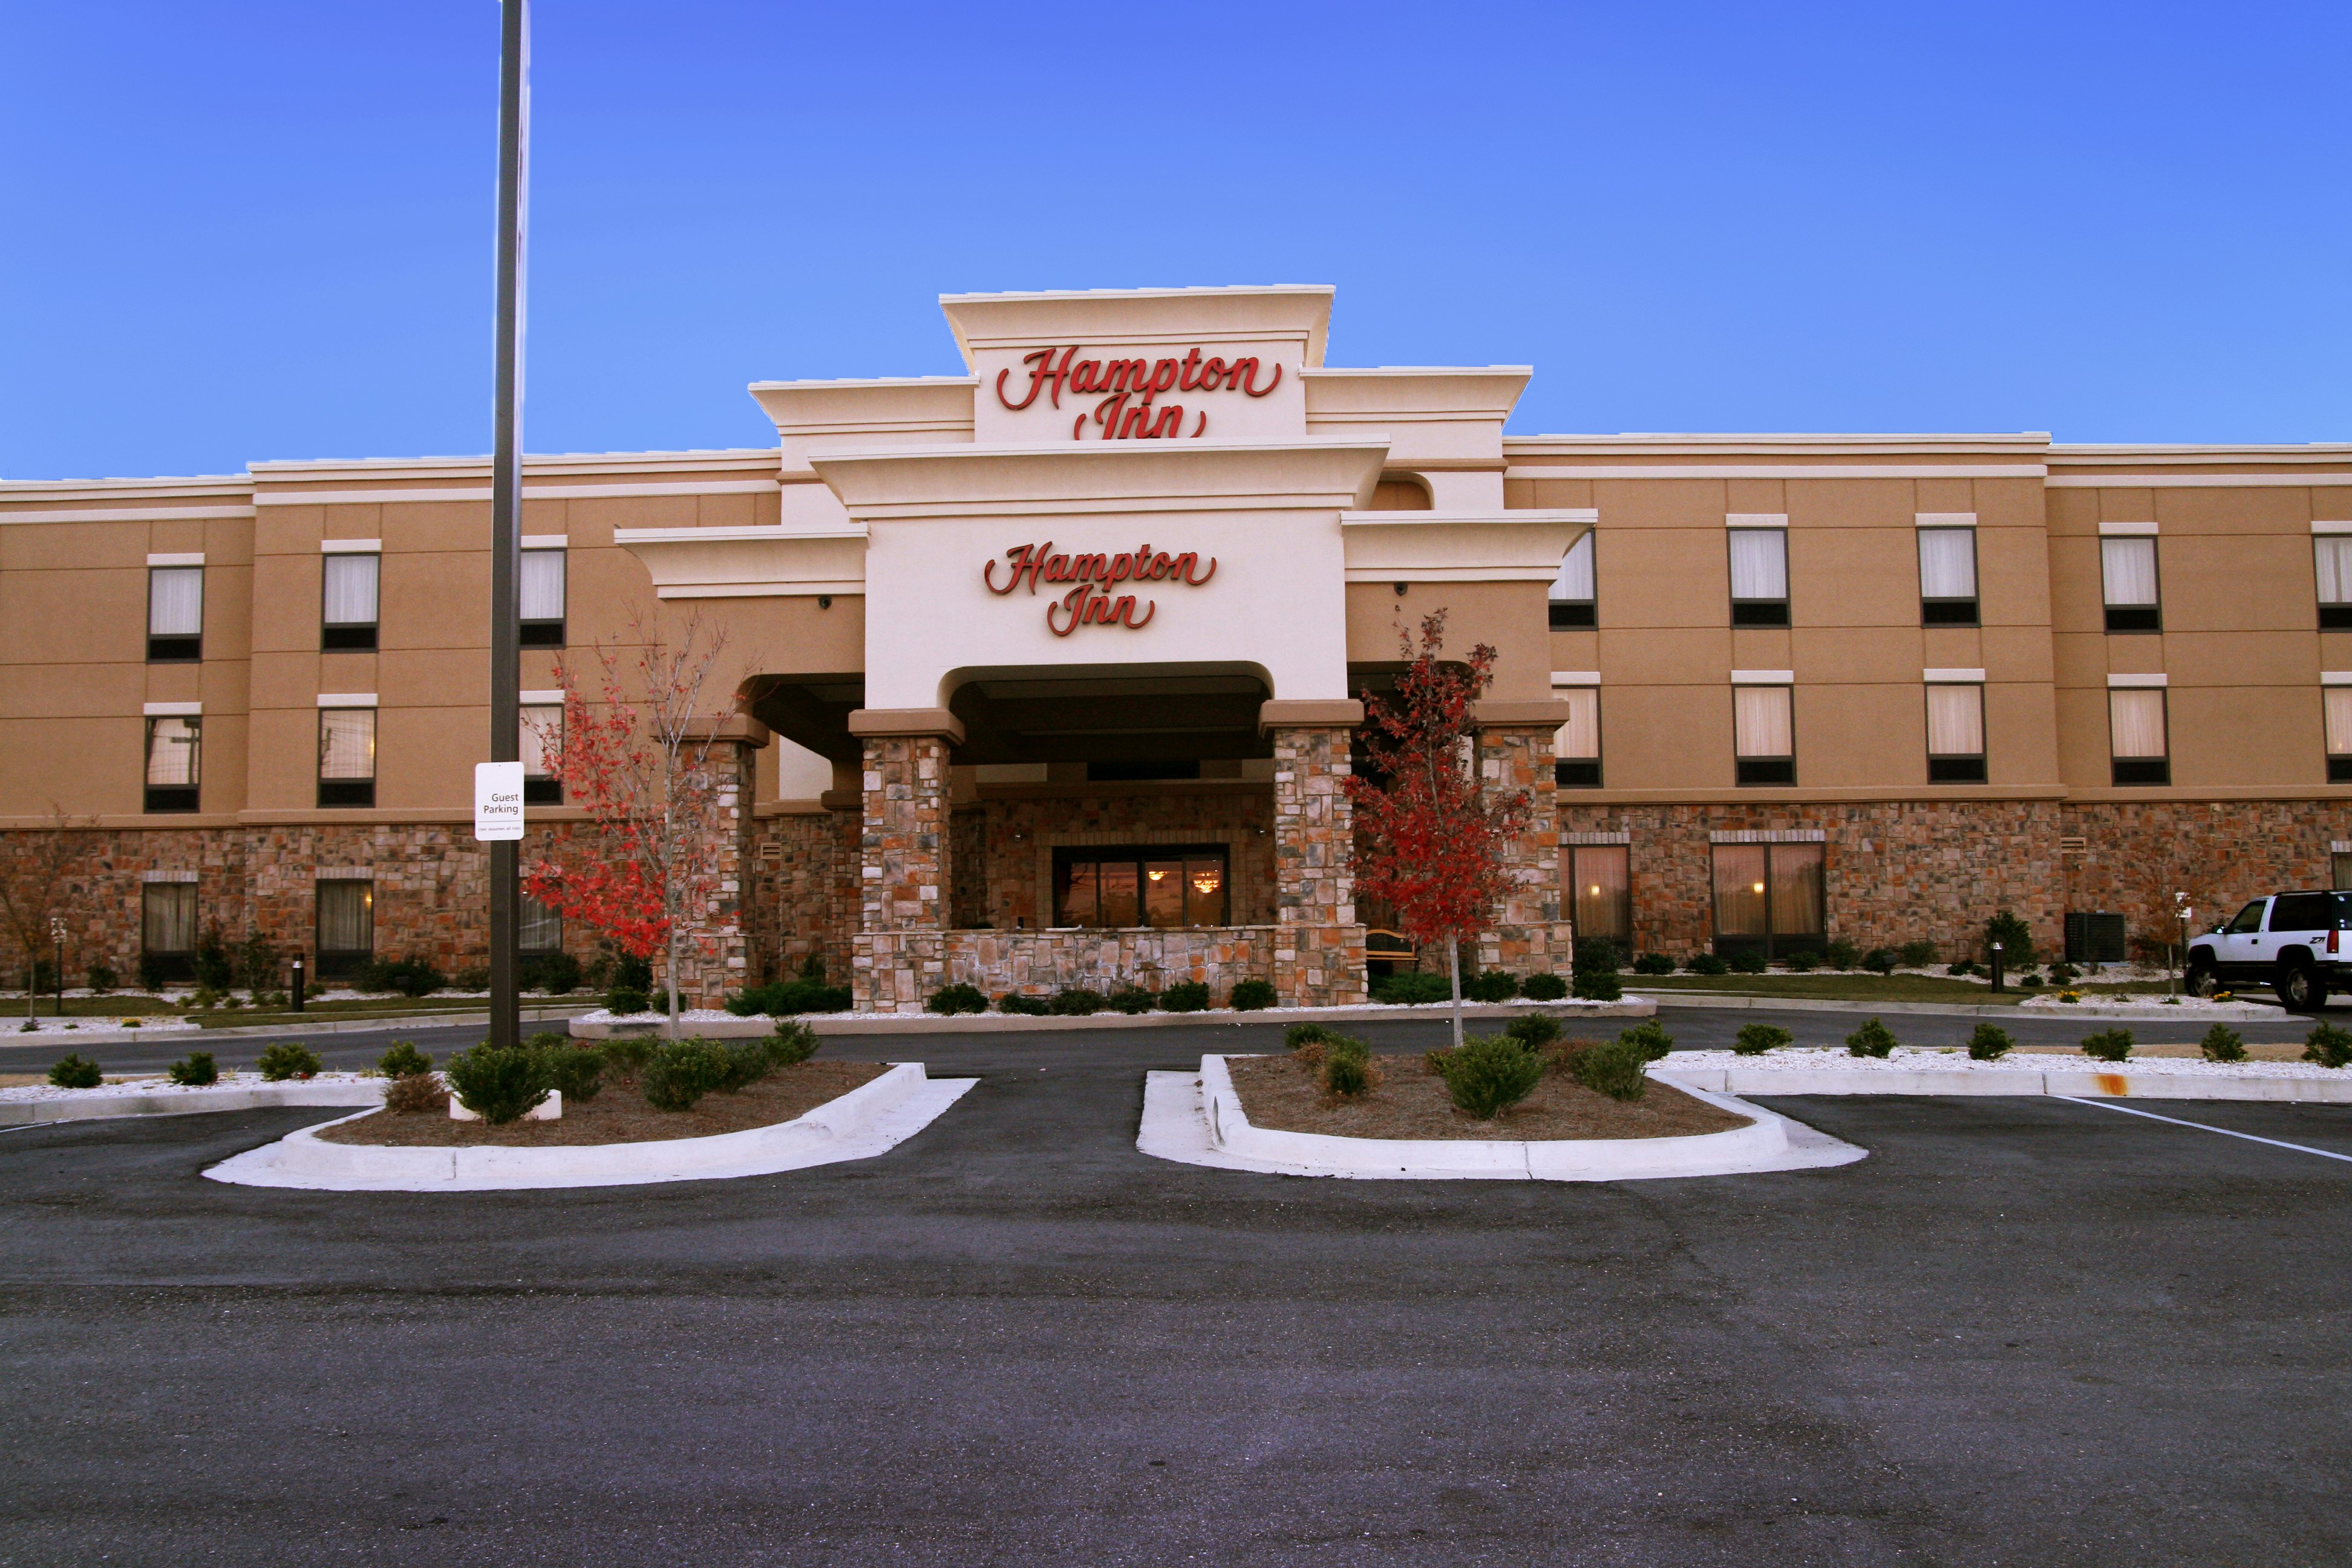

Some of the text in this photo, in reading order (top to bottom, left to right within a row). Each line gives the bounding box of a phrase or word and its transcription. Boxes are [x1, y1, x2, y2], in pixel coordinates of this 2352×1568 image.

[996, 345, 1282, 410] Hampton
[1073, 392, 1207, 440] Inn
[984, 541, 1217, 595] Hampton
[1047, 584, 1155, 637] Inn
[484, 804, 518, 815] Parking
[492, 793, 518, 802] Guest
